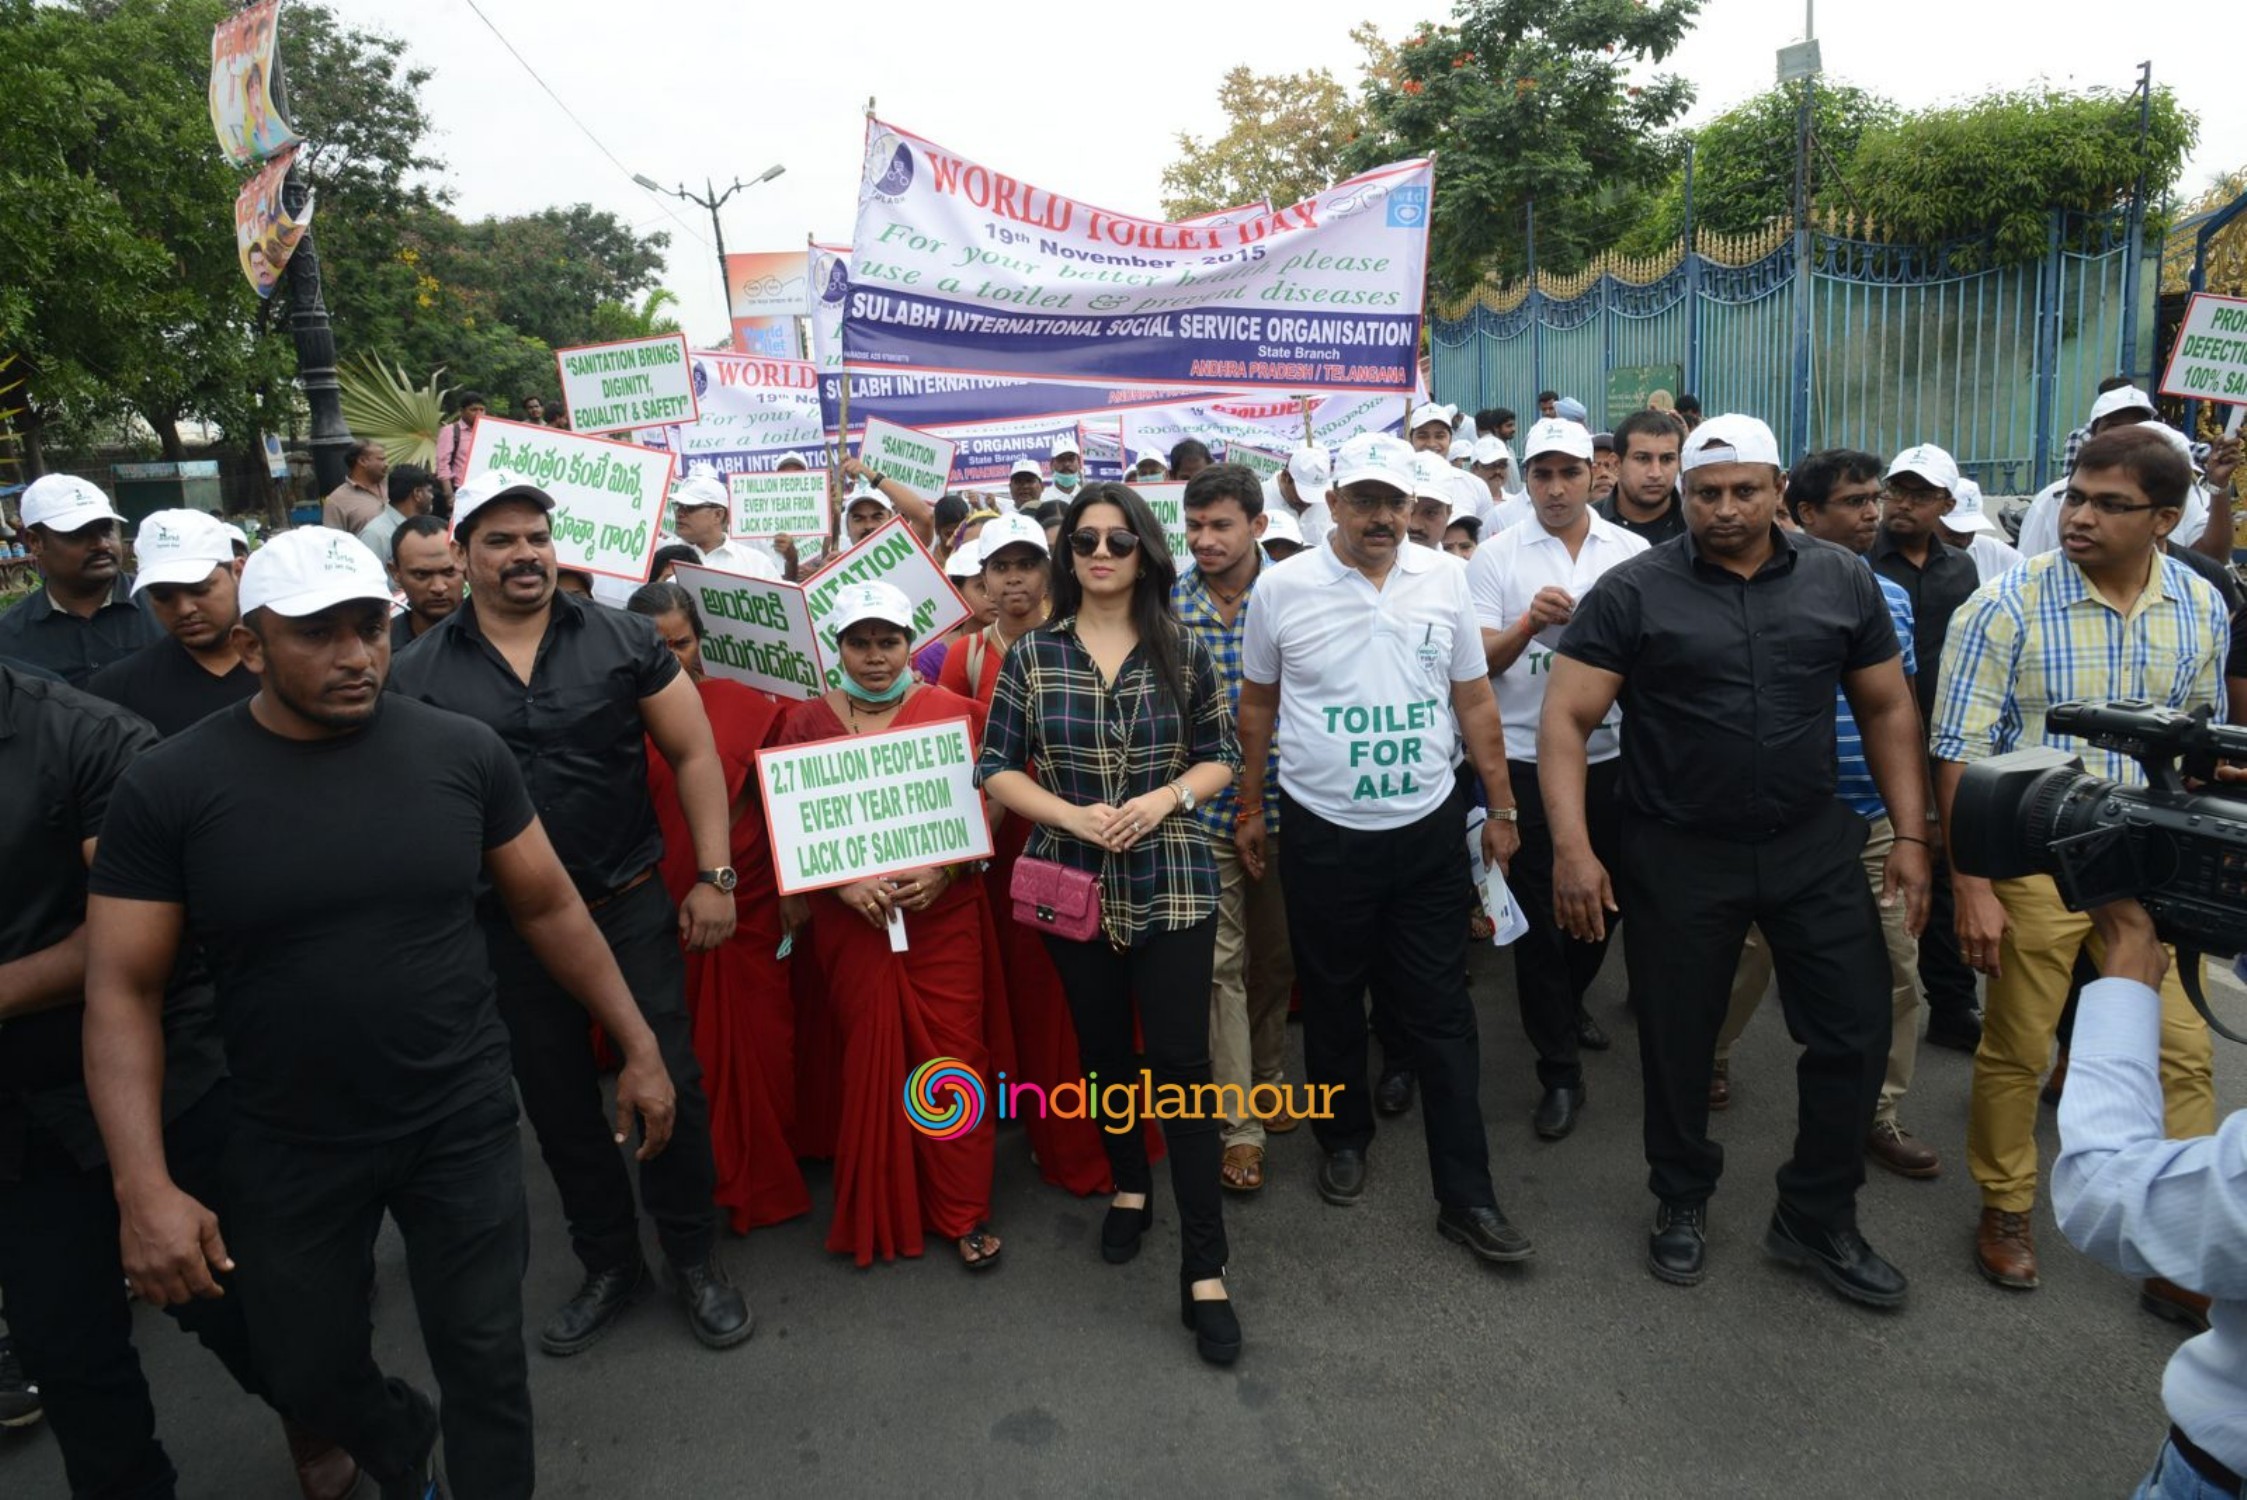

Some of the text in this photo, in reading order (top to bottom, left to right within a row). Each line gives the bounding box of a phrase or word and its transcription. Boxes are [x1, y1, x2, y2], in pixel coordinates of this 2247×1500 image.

[925, 150, 1320, 250] WORLD TOILET DAY
[875, 221, 948, 254] For
[952, 244, 1042, 276] your
[1058, 263, 1161, 288] better
[1279, 249, 1390, 275] please
[985, 222, 1031, 246] 19th
[1040, 238, 1176, 269] November
[1202, 244, 1266, 266] 2015
[859, 259, 923, 285] use
[937, 277, 962, 294] a
[976, 280, 1074, 310] toilet
[1132, 284, 1247, 314] prevent
[1260, 280, 1402, 307] diseases
[851, 291, 1413, 347] SULABH INTERNATIONAL SOCIAL SERVICE ORGANISATION
[638, 343, 681, 367] BRINGS
[1257, 345, 1340, 361] State Branch
[716, 361, 817, 389] WORLD
[1189, 359, 1248, 379] ANDHRA
[1249, 361, 1314, 381] PRADESH
[1324, 364, 1407, 384] TELANGANA
[2183, 365, 2222, 393] 100%
[602, 373, 654, 399] DIGINITY,
[574, 402, 629, 429] EQUALITY
[631, 402, 641, 421] &
[694, 412, 738, 427] For
[746, 409, 795, 427] your
[689, 435, 725, 449] use
[737, 435, 751, 446] a
[762, 427, 820, 445] toilet
[746, 478, 778, 494] MILLION
[780, 477, 809, 492] PEOPLE
[811, 476, 823, 491] DIE
[881, 460, 915, 484] HUMAN
[744, 496, 815, 513] EVERY YEAR FROM
[740, 515, 820, 532] LACK OF SANITATION
[1322, 699, 1438, 734] TOILET
[770, 731, 966, 795] 2.7 MILLION PEOPLE DIE
[1349, 736, 1423, 768] FOR
[1352, 771, 1419, 801] ALL
[799, 776, 953, 834] EVERY YEAR FROM
[797, 816, 970, 878] LACK OF SANITATION
